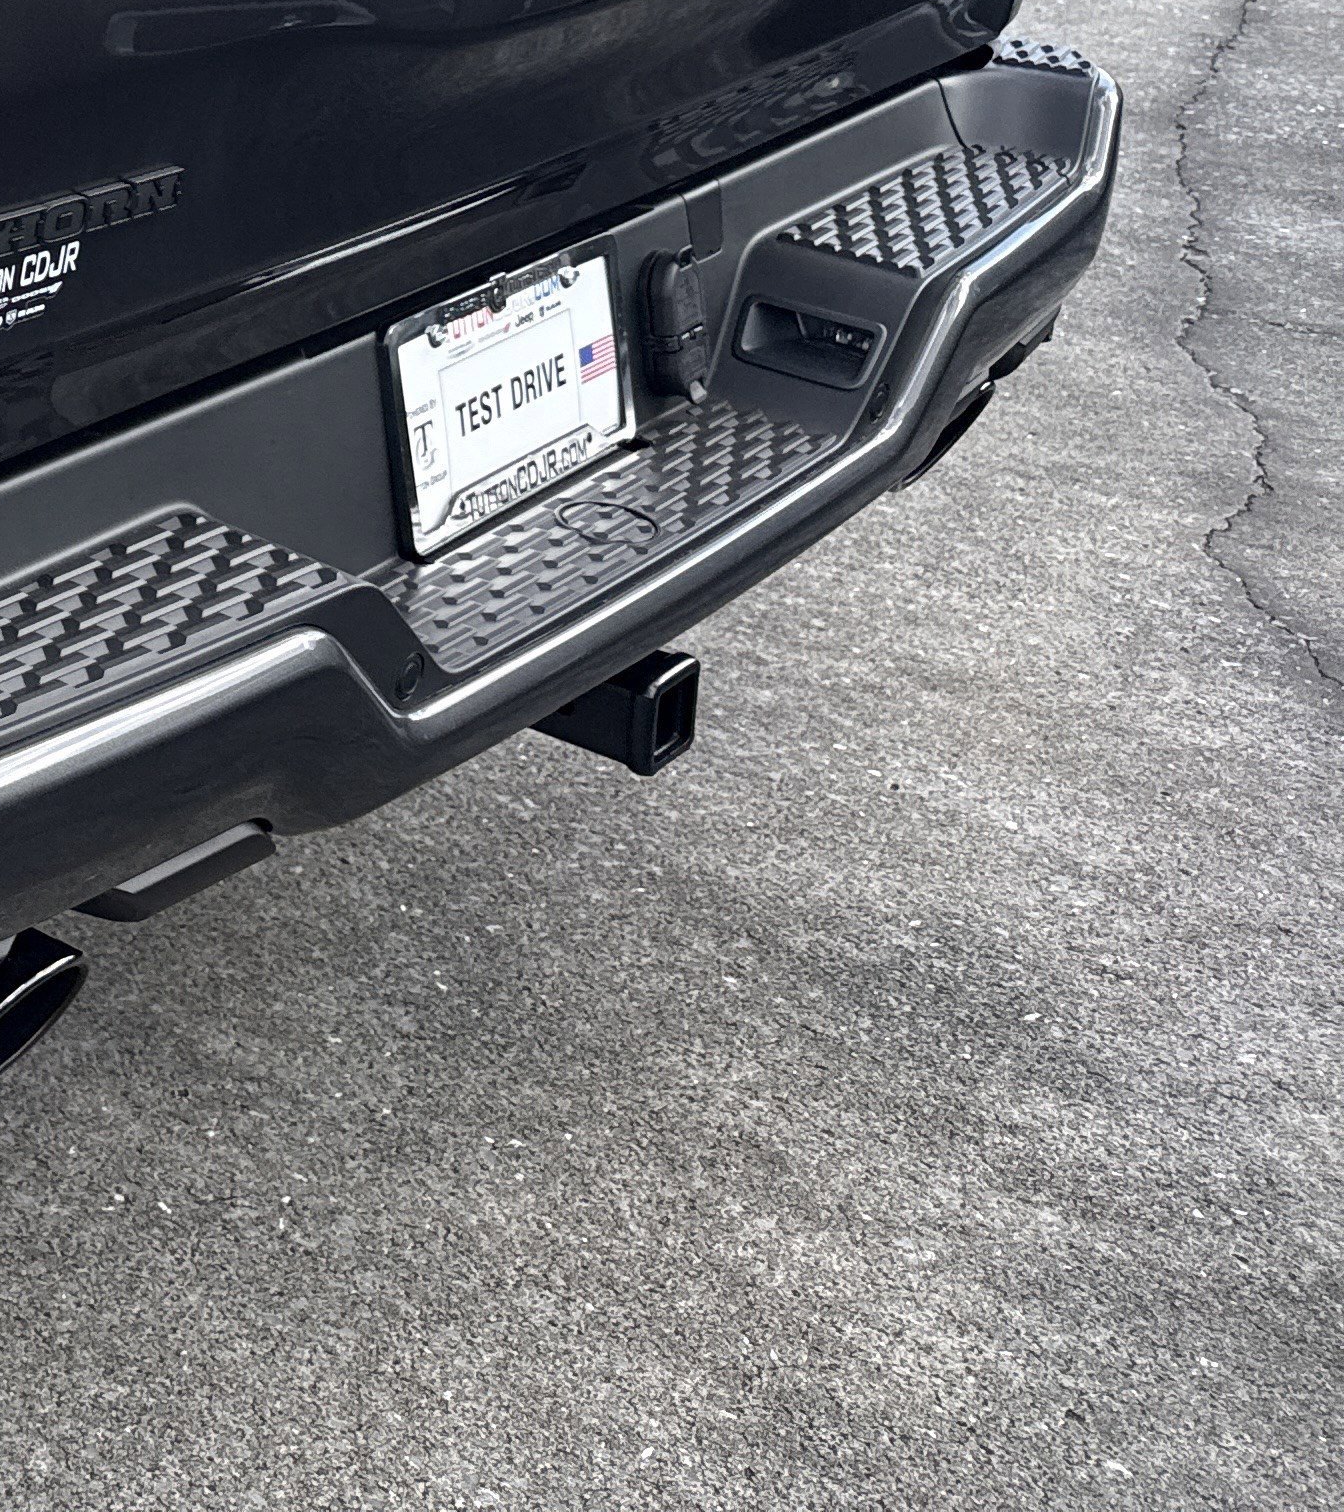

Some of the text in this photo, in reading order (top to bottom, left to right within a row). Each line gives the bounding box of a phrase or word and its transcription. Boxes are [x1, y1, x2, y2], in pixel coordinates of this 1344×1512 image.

[19, 240, 80, 287] CDJR
[514, 311, 534, 328] Jeep
[455, 353, 567, 438] TEST DRIVE
